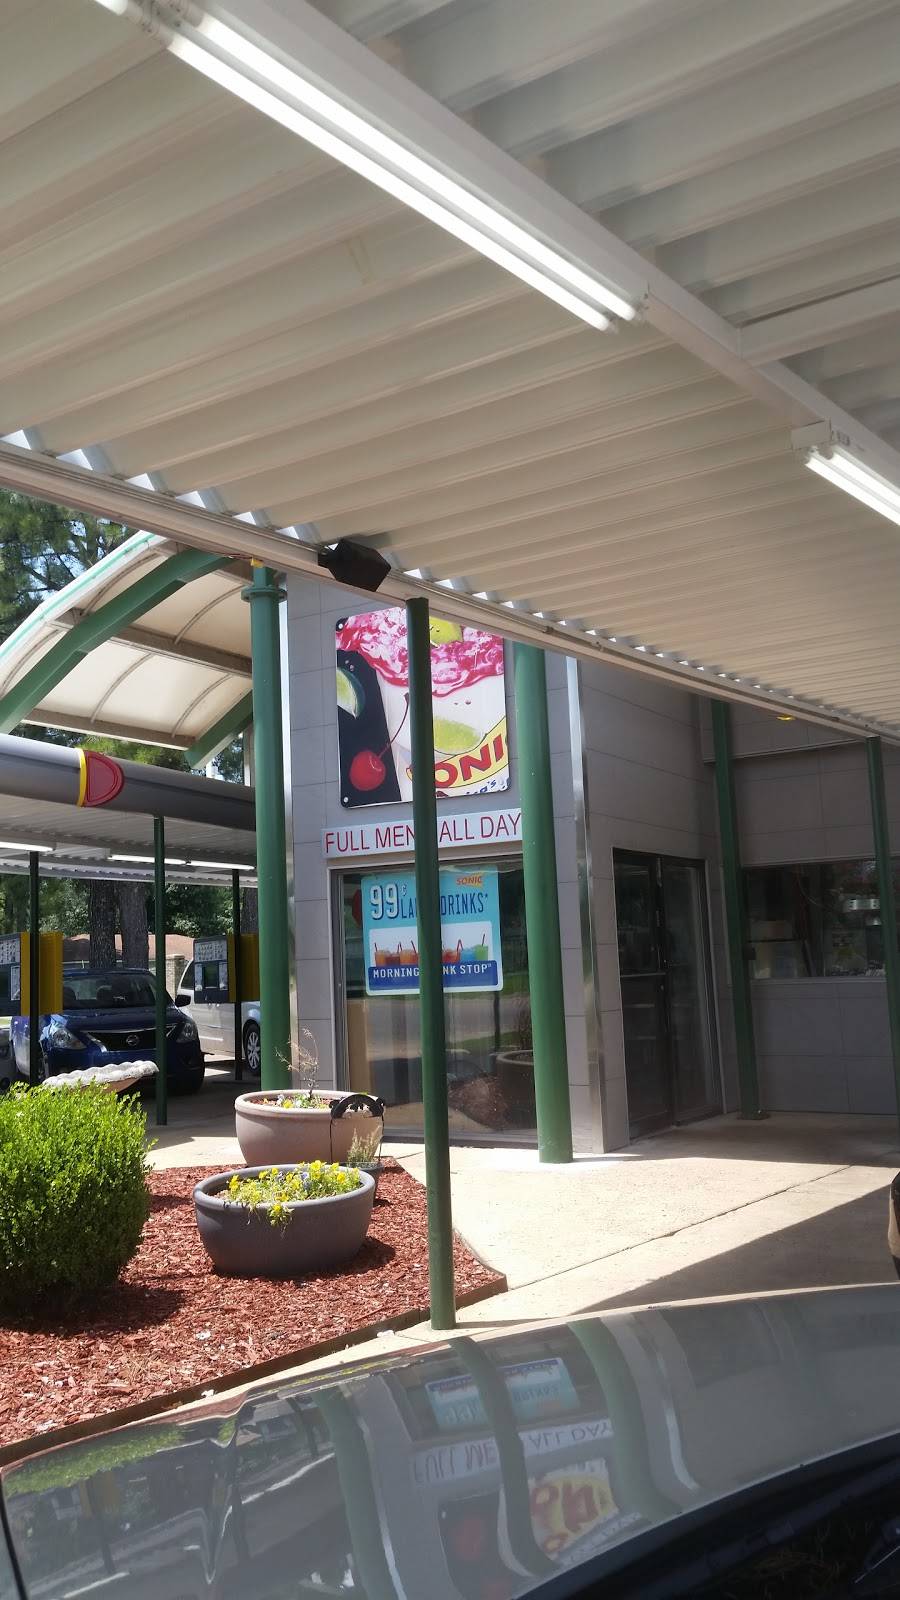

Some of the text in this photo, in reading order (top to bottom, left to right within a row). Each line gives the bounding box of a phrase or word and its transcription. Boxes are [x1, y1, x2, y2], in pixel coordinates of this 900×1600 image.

[326, 812, 521, 853] FULL MEN ALL DAY
[456, 875, 483, 886] SONIC
[373, 967, 420, 978] MORNING
